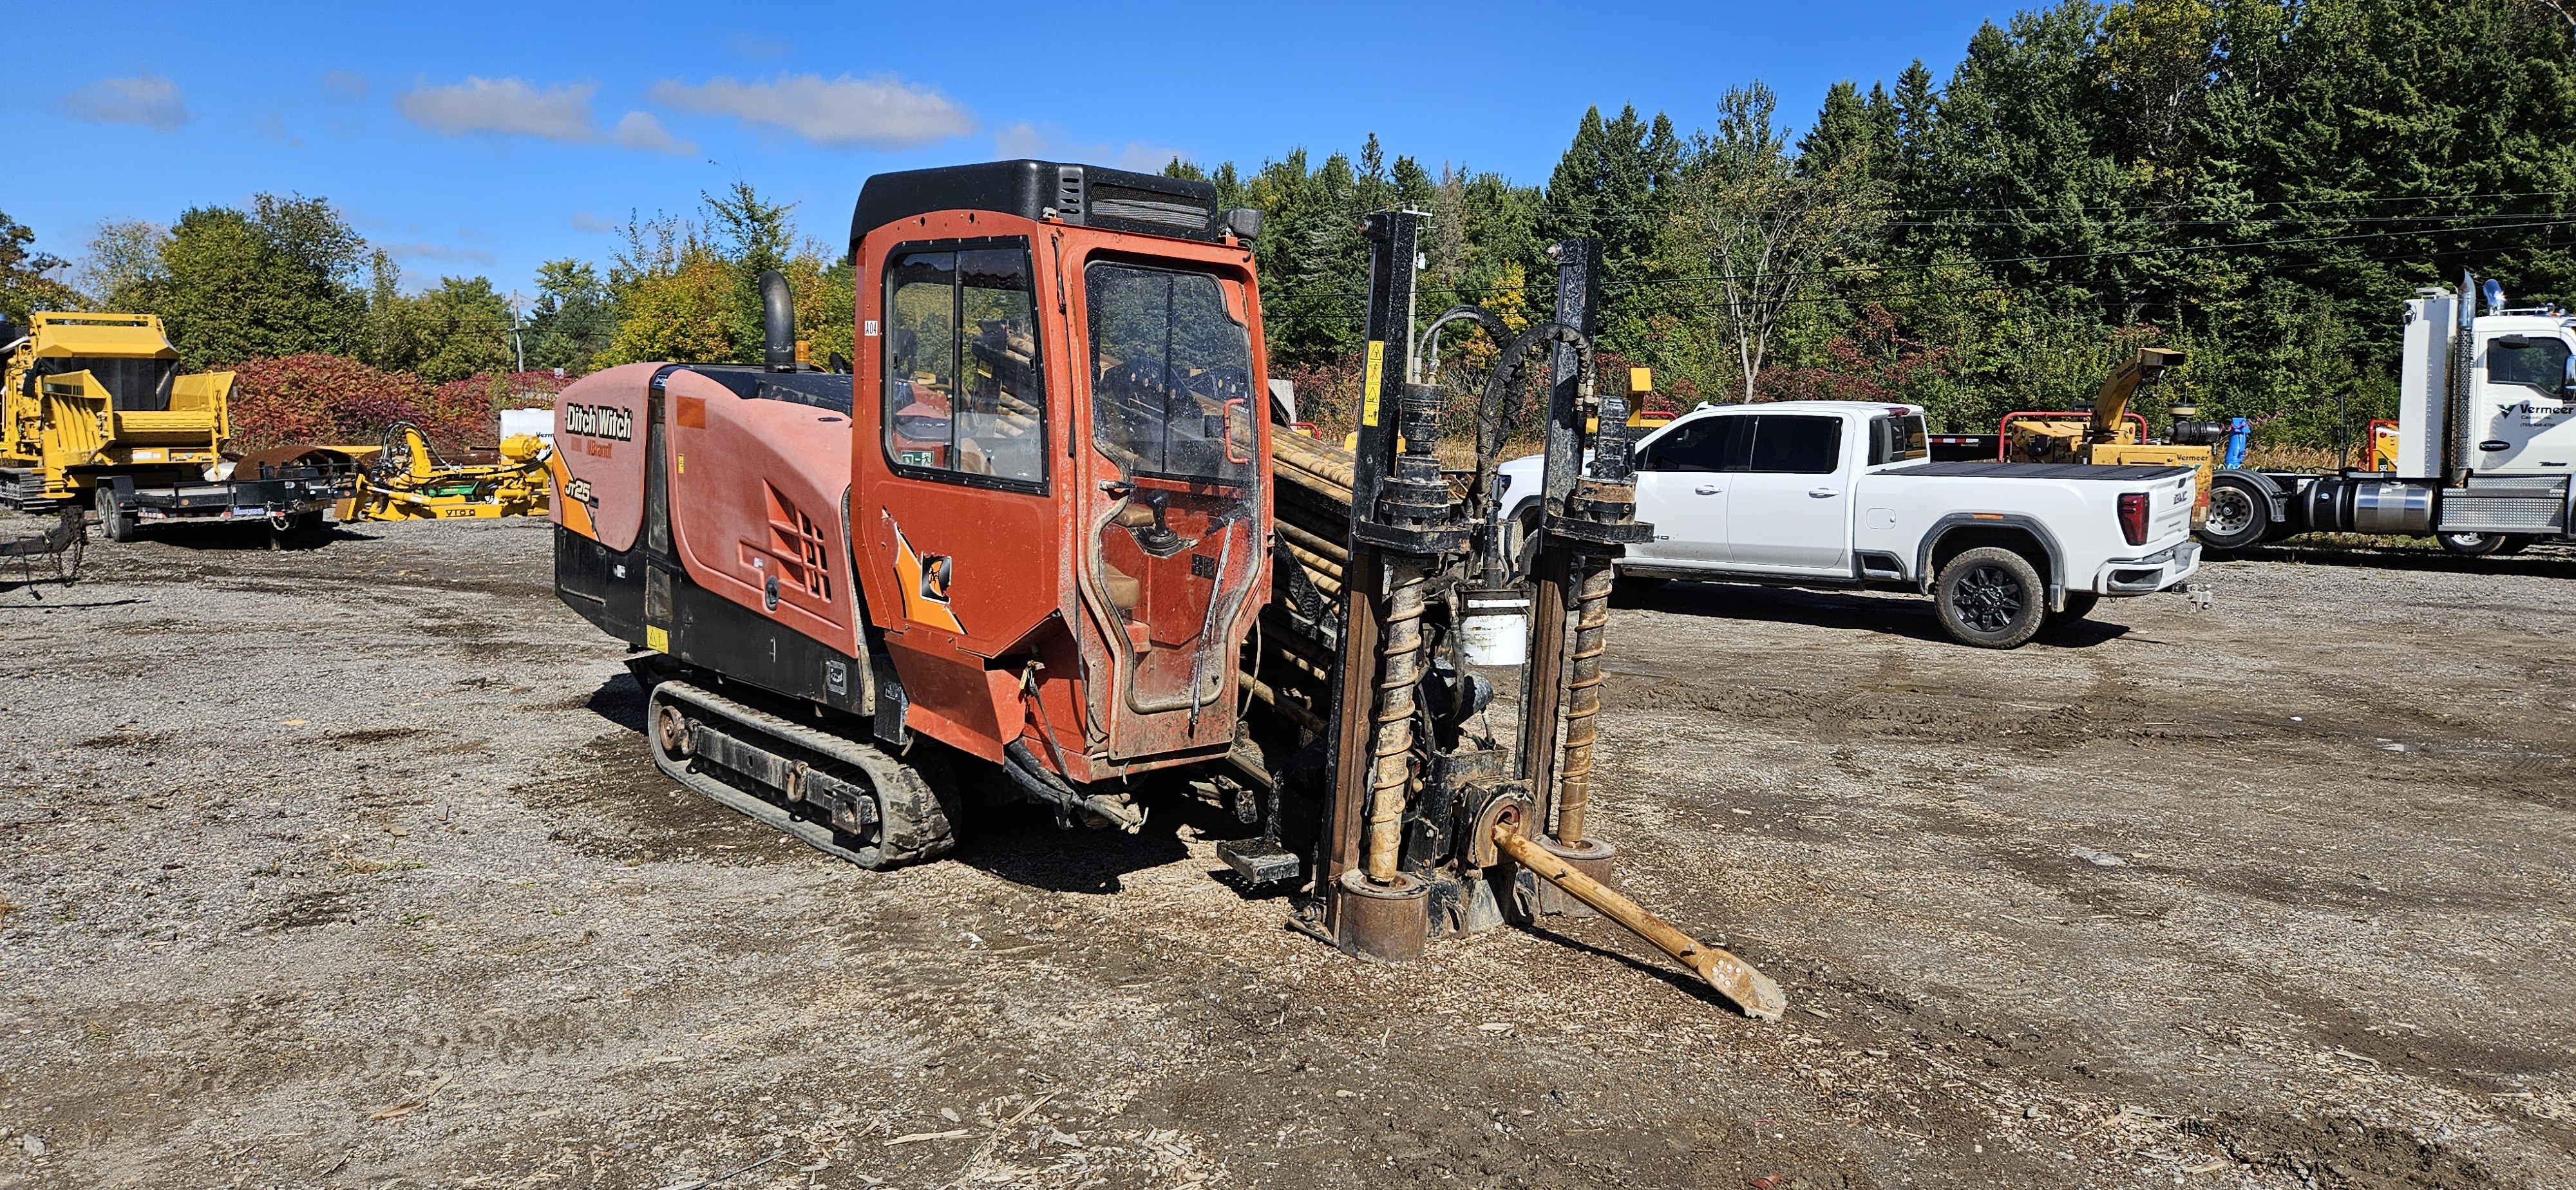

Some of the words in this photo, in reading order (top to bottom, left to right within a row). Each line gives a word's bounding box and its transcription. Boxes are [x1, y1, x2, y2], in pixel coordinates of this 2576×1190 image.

[2520, 404, 2574, 414] Vermeer
[567, 405, 596, 433] Ditch
[598, 408, 631, 438] Witch
[565, 480, 591, 502] JT25
